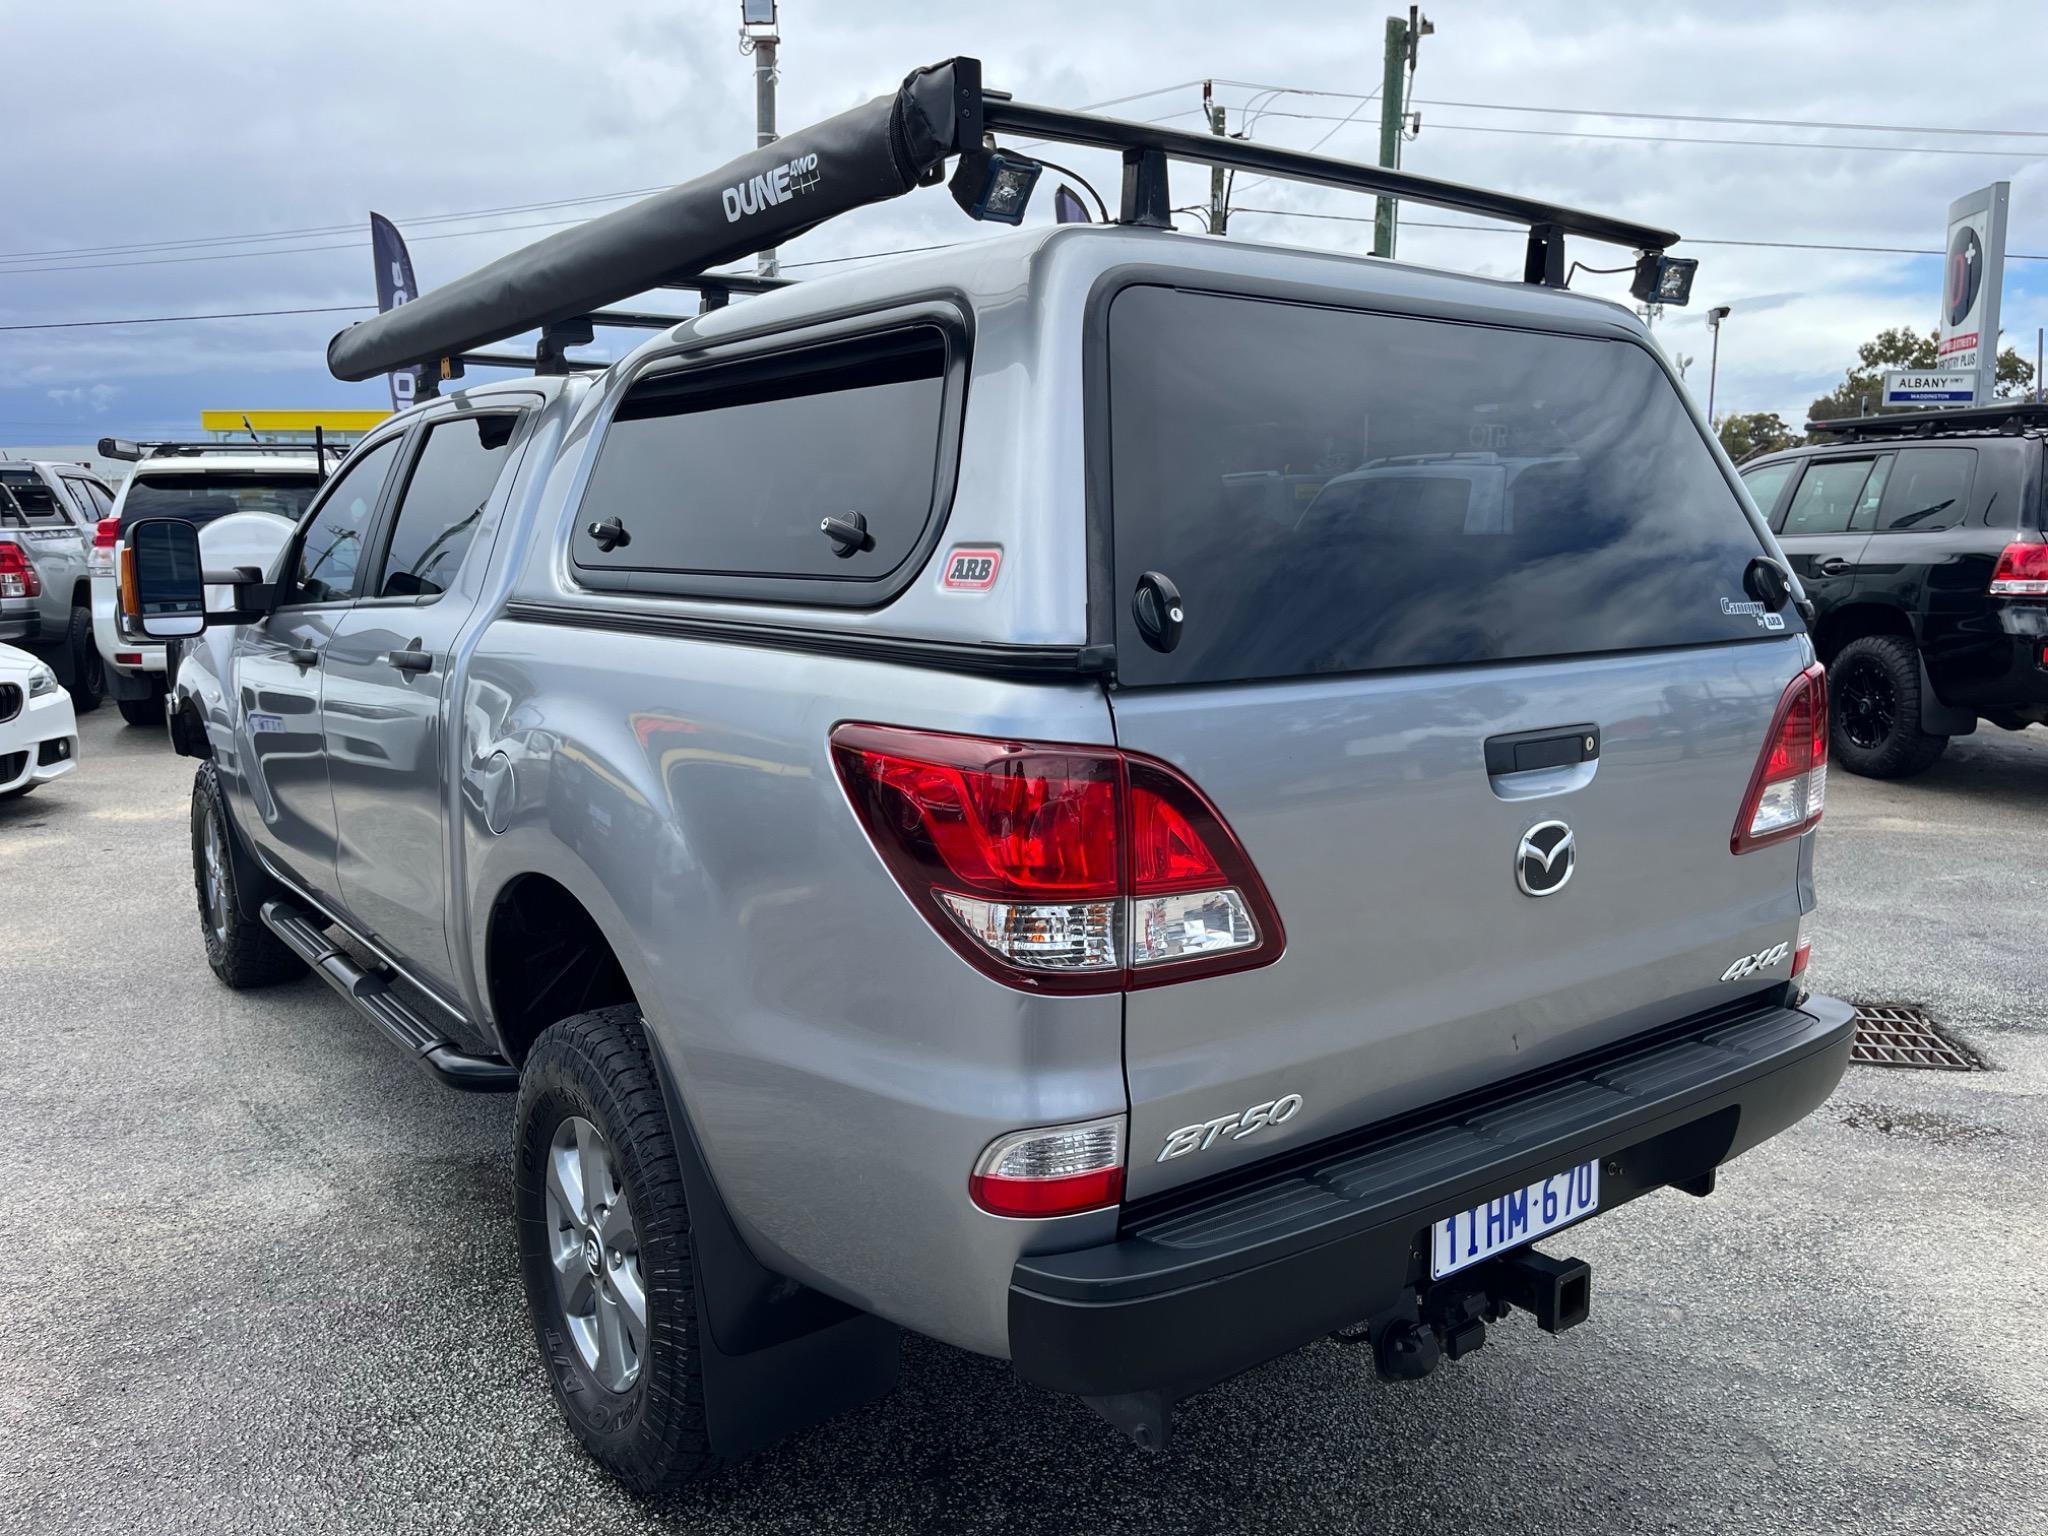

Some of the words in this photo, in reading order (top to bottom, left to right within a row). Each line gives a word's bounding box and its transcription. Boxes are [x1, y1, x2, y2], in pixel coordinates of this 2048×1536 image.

[722, 164, 793, 223] DUNE
[789, 153, 818, 177] 4WD
[1898, 378, 1948, 388] ALBANY
[949, 558, 993, 580] ARB
[1720, 597, 1766, 617] Canopy
[1156, 1093, 1304, 1163] BT-50
